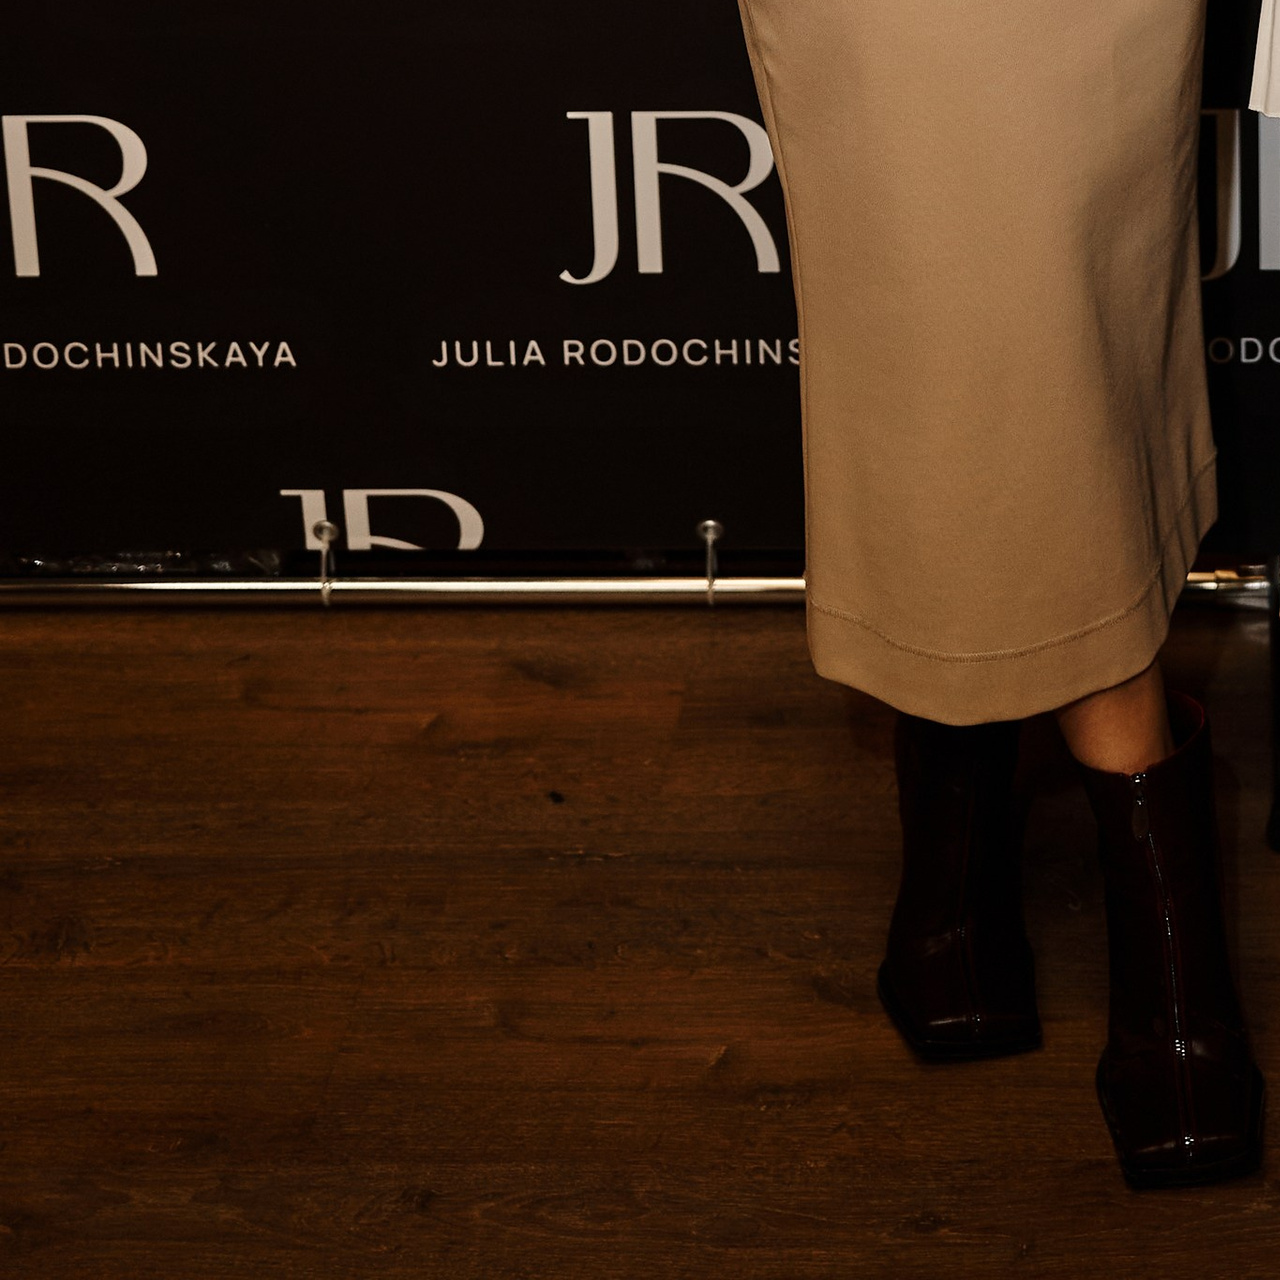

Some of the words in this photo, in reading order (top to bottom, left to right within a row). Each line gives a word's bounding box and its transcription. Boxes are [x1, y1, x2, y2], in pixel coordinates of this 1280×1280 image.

[560, 111, 781, 285] JR
[4, 341, 297, 369] DOCHINSKAYA
[432, 339, 546, 367] JULIA
